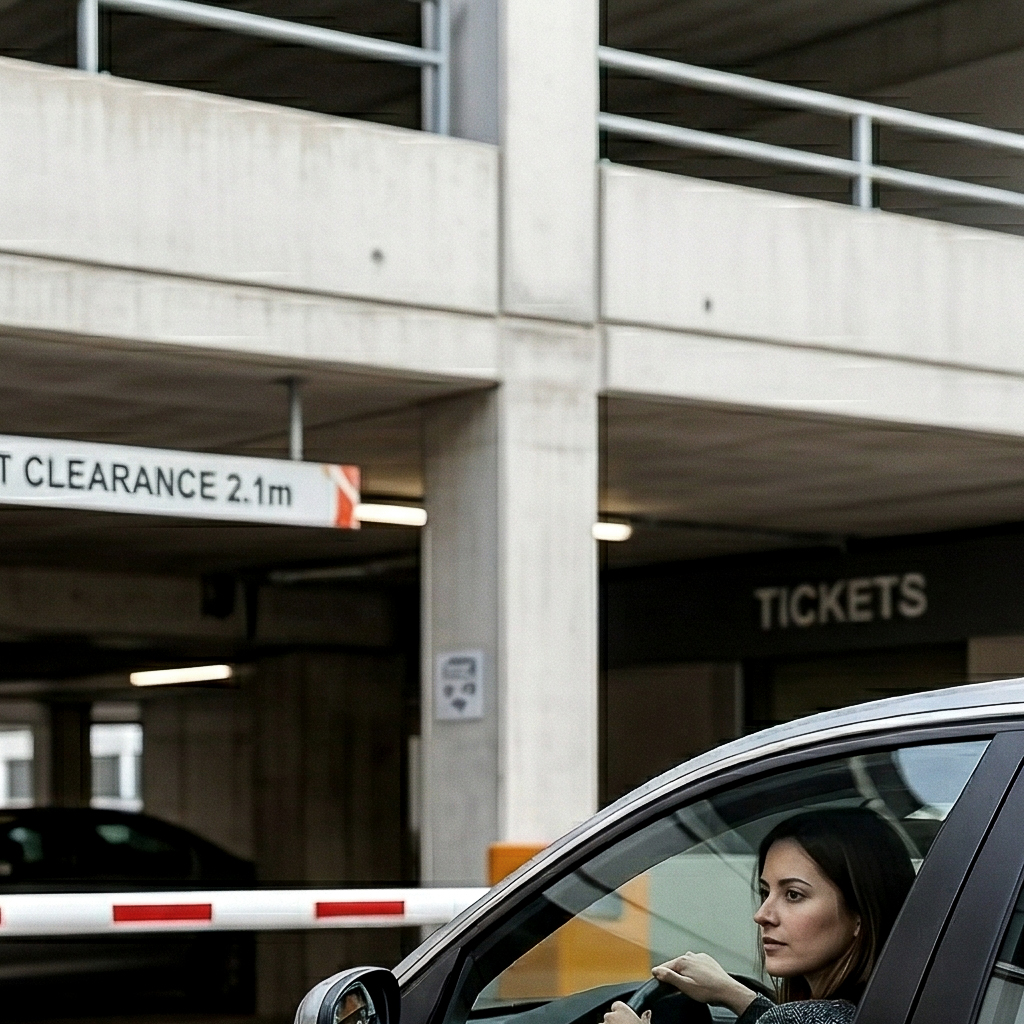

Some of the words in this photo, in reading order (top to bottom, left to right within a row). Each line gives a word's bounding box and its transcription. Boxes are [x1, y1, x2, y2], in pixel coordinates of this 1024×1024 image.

[24, 455, 217, 501] CLEARANCE
[226, 473, 293, 507] 2.1m
[753, 571, 928, 631] TICKETS
